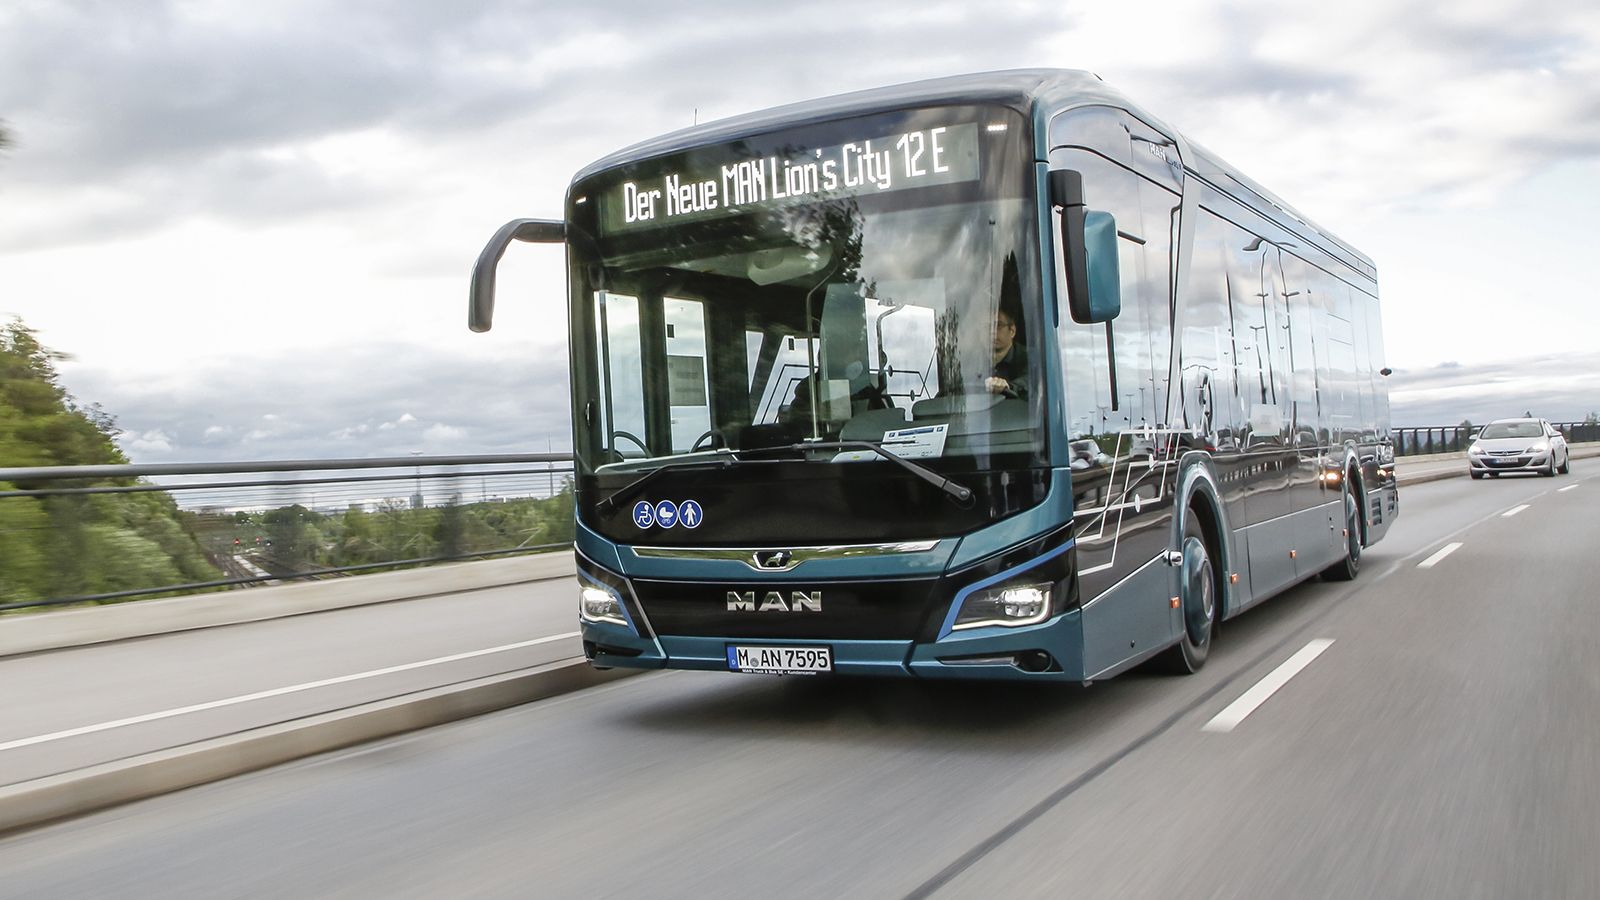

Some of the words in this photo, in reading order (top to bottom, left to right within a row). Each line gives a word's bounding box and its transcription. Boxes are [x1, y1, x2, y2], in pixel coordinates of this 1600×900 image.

[624, 182, 661, 223] Der
[665, 174, 718, 216] Neue
[722, 159, 766, 208] MAN
[770, 149, 837, 199] Lion's
[842, 140, 891, 189] City
[896, 131, 926, 178] 12
[931, 127, 949, 173] E
[727, 591, 822, 611] MAN
[785, 650, 828, 668] 7595
